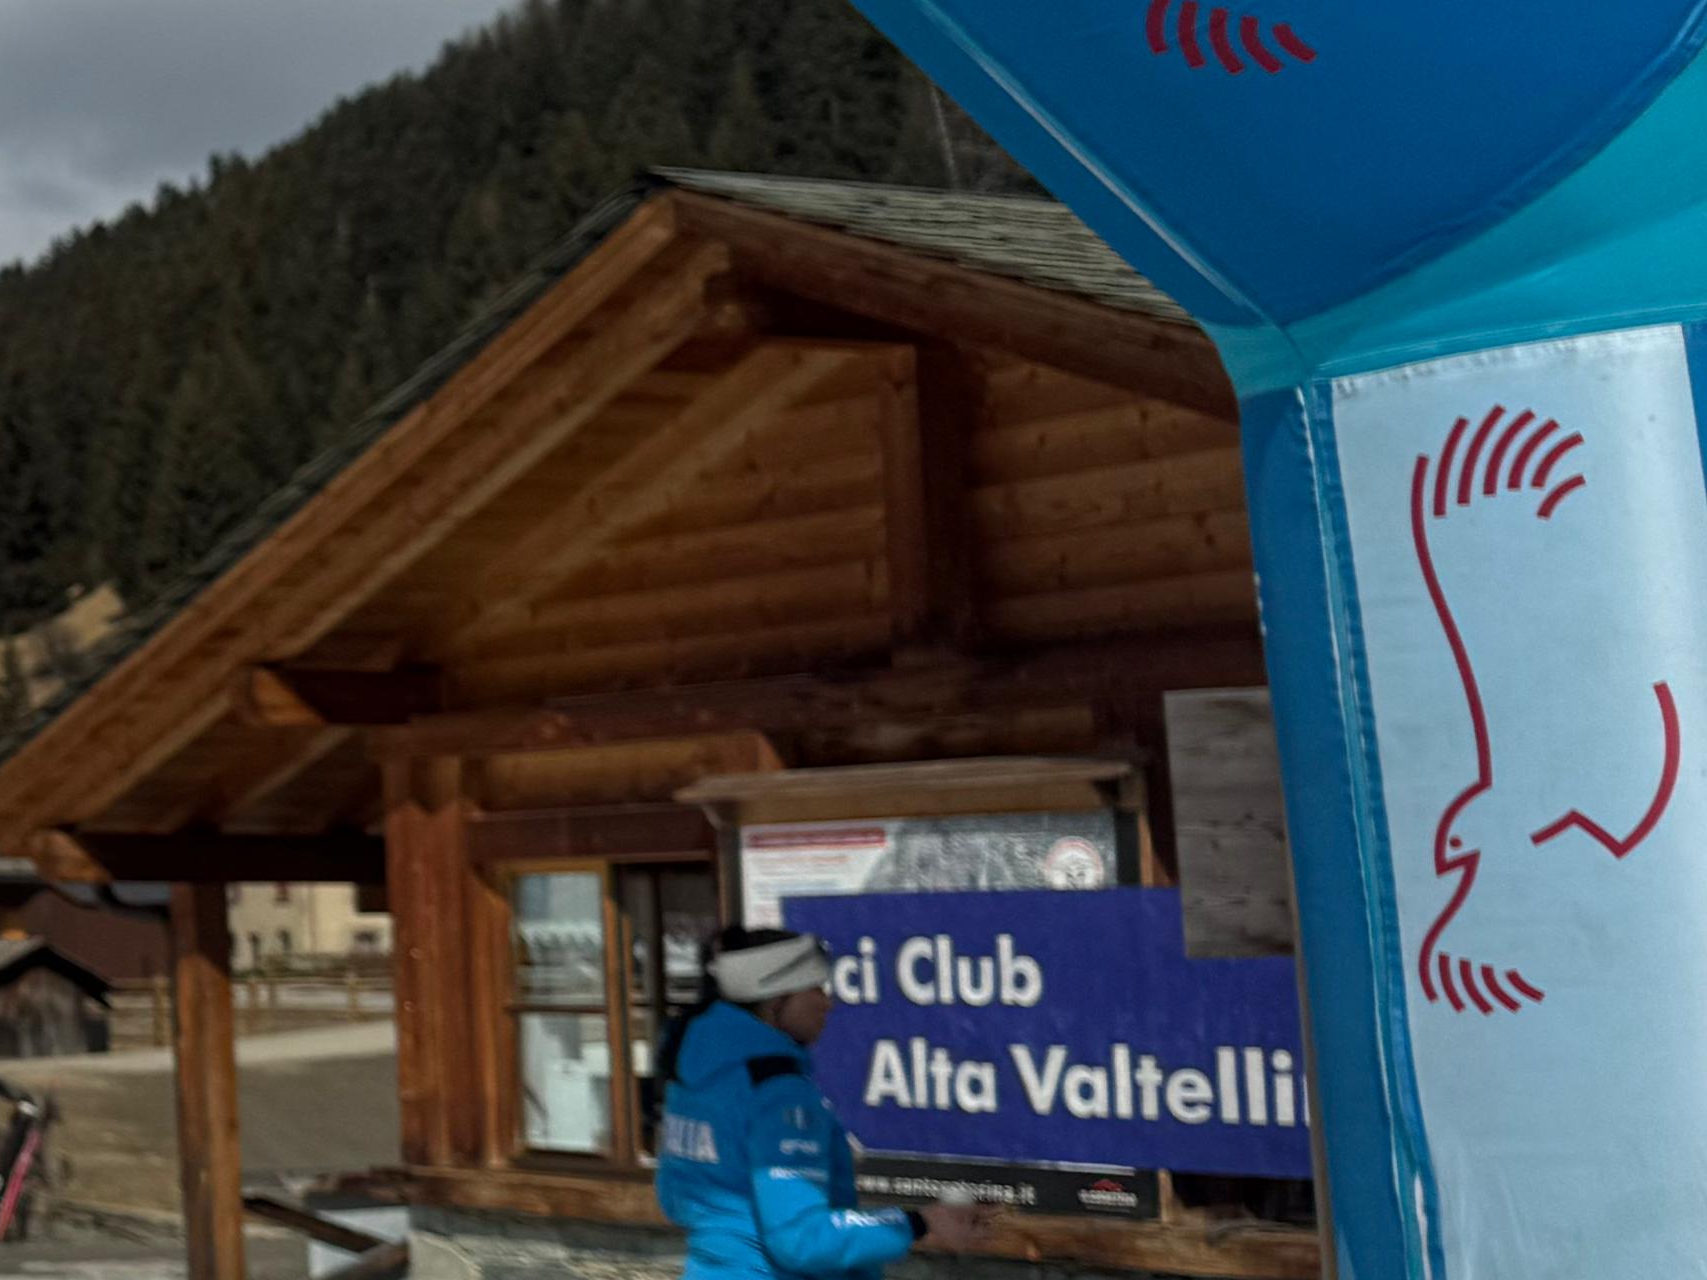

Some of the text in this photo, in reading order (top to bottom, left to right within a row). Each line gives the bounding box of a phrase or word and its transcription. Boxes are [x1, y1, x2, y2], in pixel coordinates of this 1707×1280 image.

[896, 932, 1044, 1009] Club
[864, 1037, 1313, 1129] Alta Valtelli
